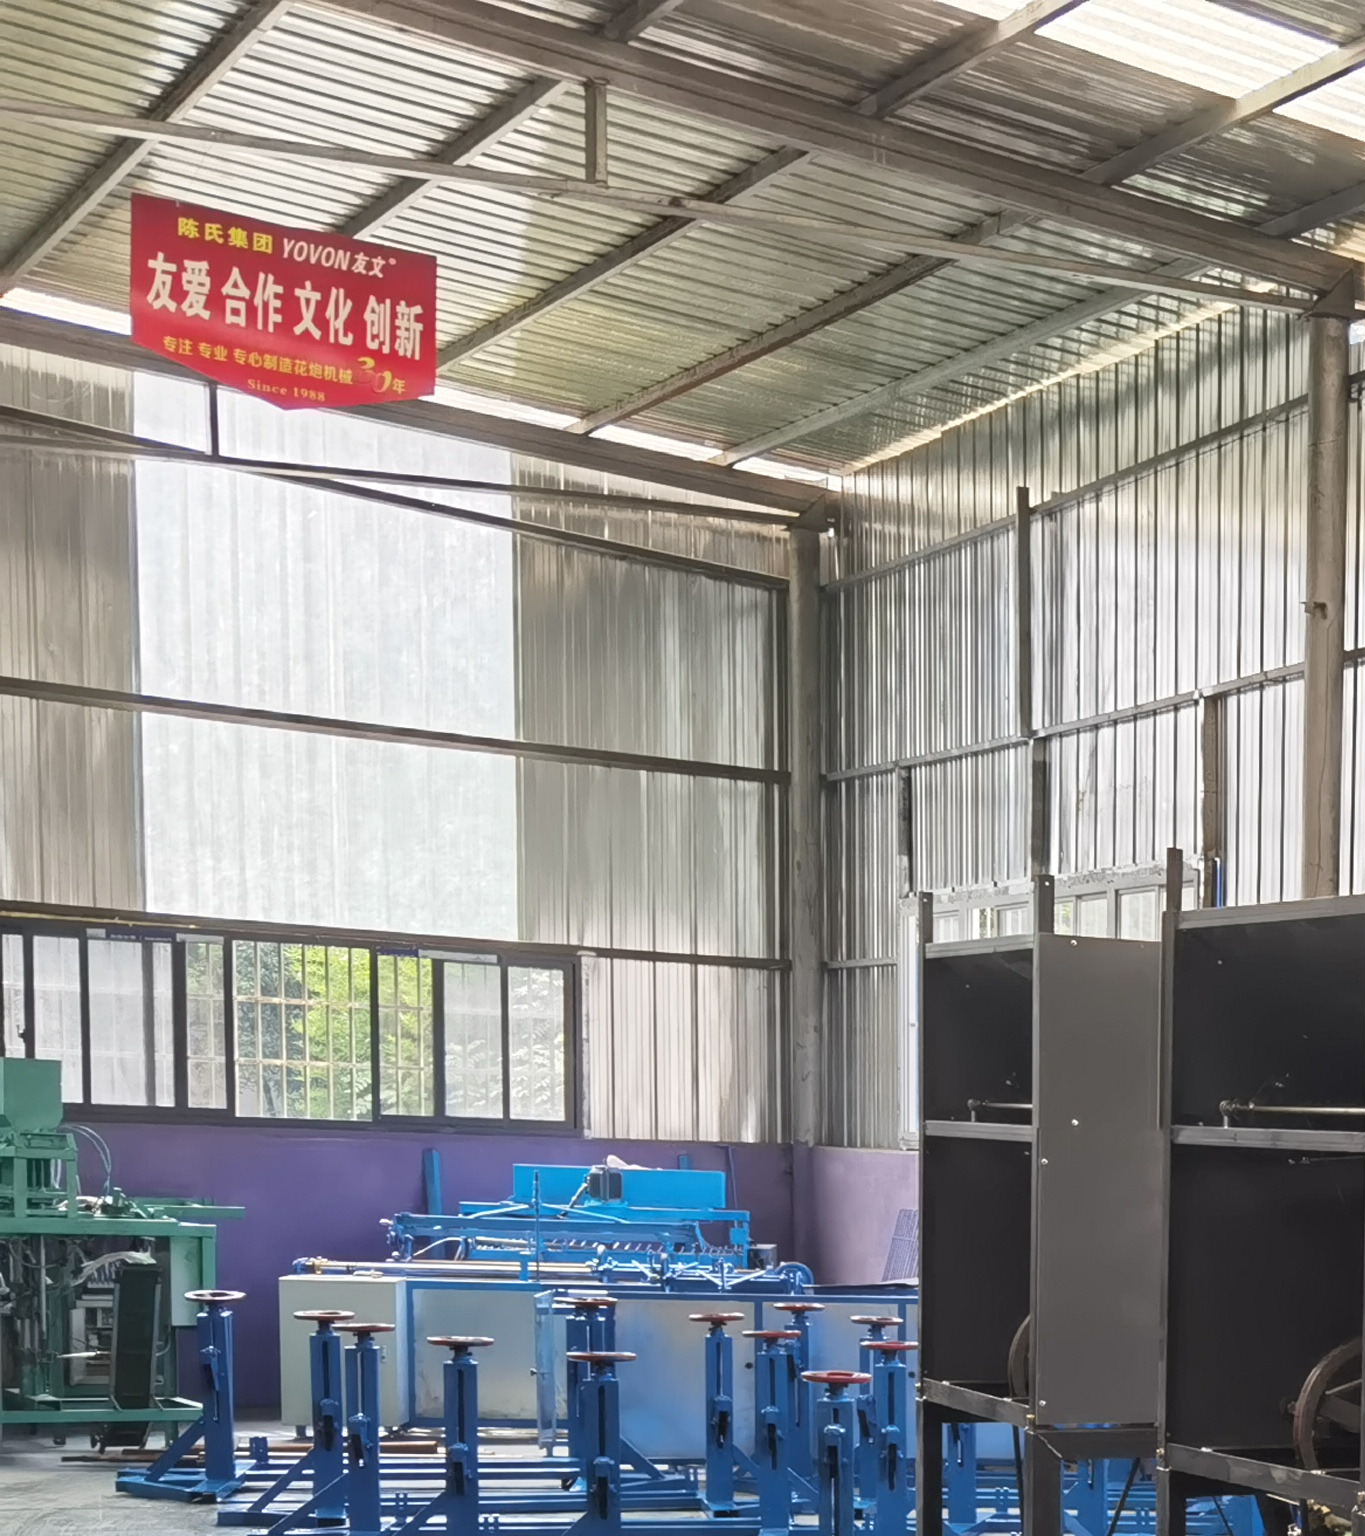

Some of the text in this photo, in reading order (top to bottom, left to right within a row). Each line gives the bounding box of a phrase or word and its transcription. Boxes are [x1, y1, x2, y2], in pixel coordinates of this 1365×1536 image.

[177, 217, 273, 254] 陈氏集团
[282, 238, 351, 271] YOVON
[146, 252, 424, 361] 友爱 合作 文化 创新
[162, 335, 193, 356] 专注
[197, 342, 228, 362] 专业
[247, 378, 326, 402] Since 1988
